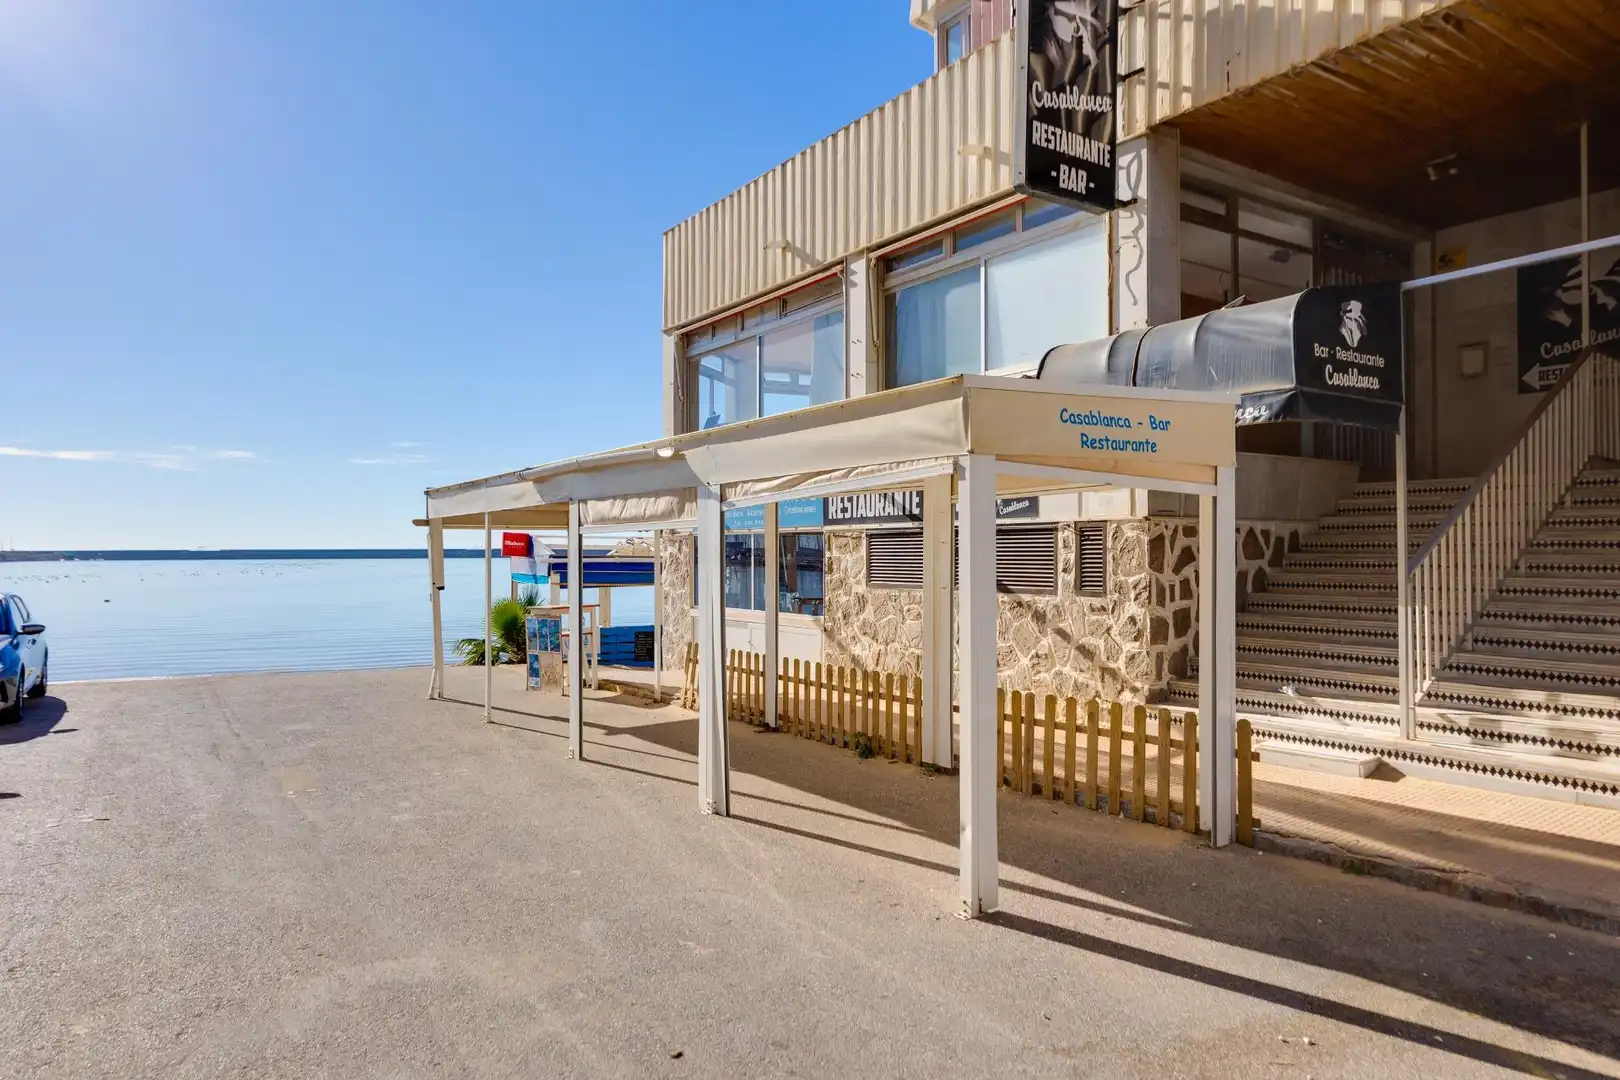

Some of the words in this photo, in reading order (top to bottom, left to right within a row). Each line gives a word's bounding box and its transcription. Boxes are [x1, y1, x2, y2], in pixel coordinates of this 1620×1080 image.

[1032, 81, 1113, 113] Casablanca
[1032, 120, 1111, 168] RESTAURANTE
[1314, 343, 1329, 358] Bar
[1336, 346, 1385, 368] Restaurante
[1325, 364, 1380, 390] Casablanca
[1060, 407, 1132, 429] Casablanca
[1149, 414, 1171, 431] Bar
[1080, 432, 1158, 453] Restaurante
[828, 490, 920, 520] RESTAURANTE
